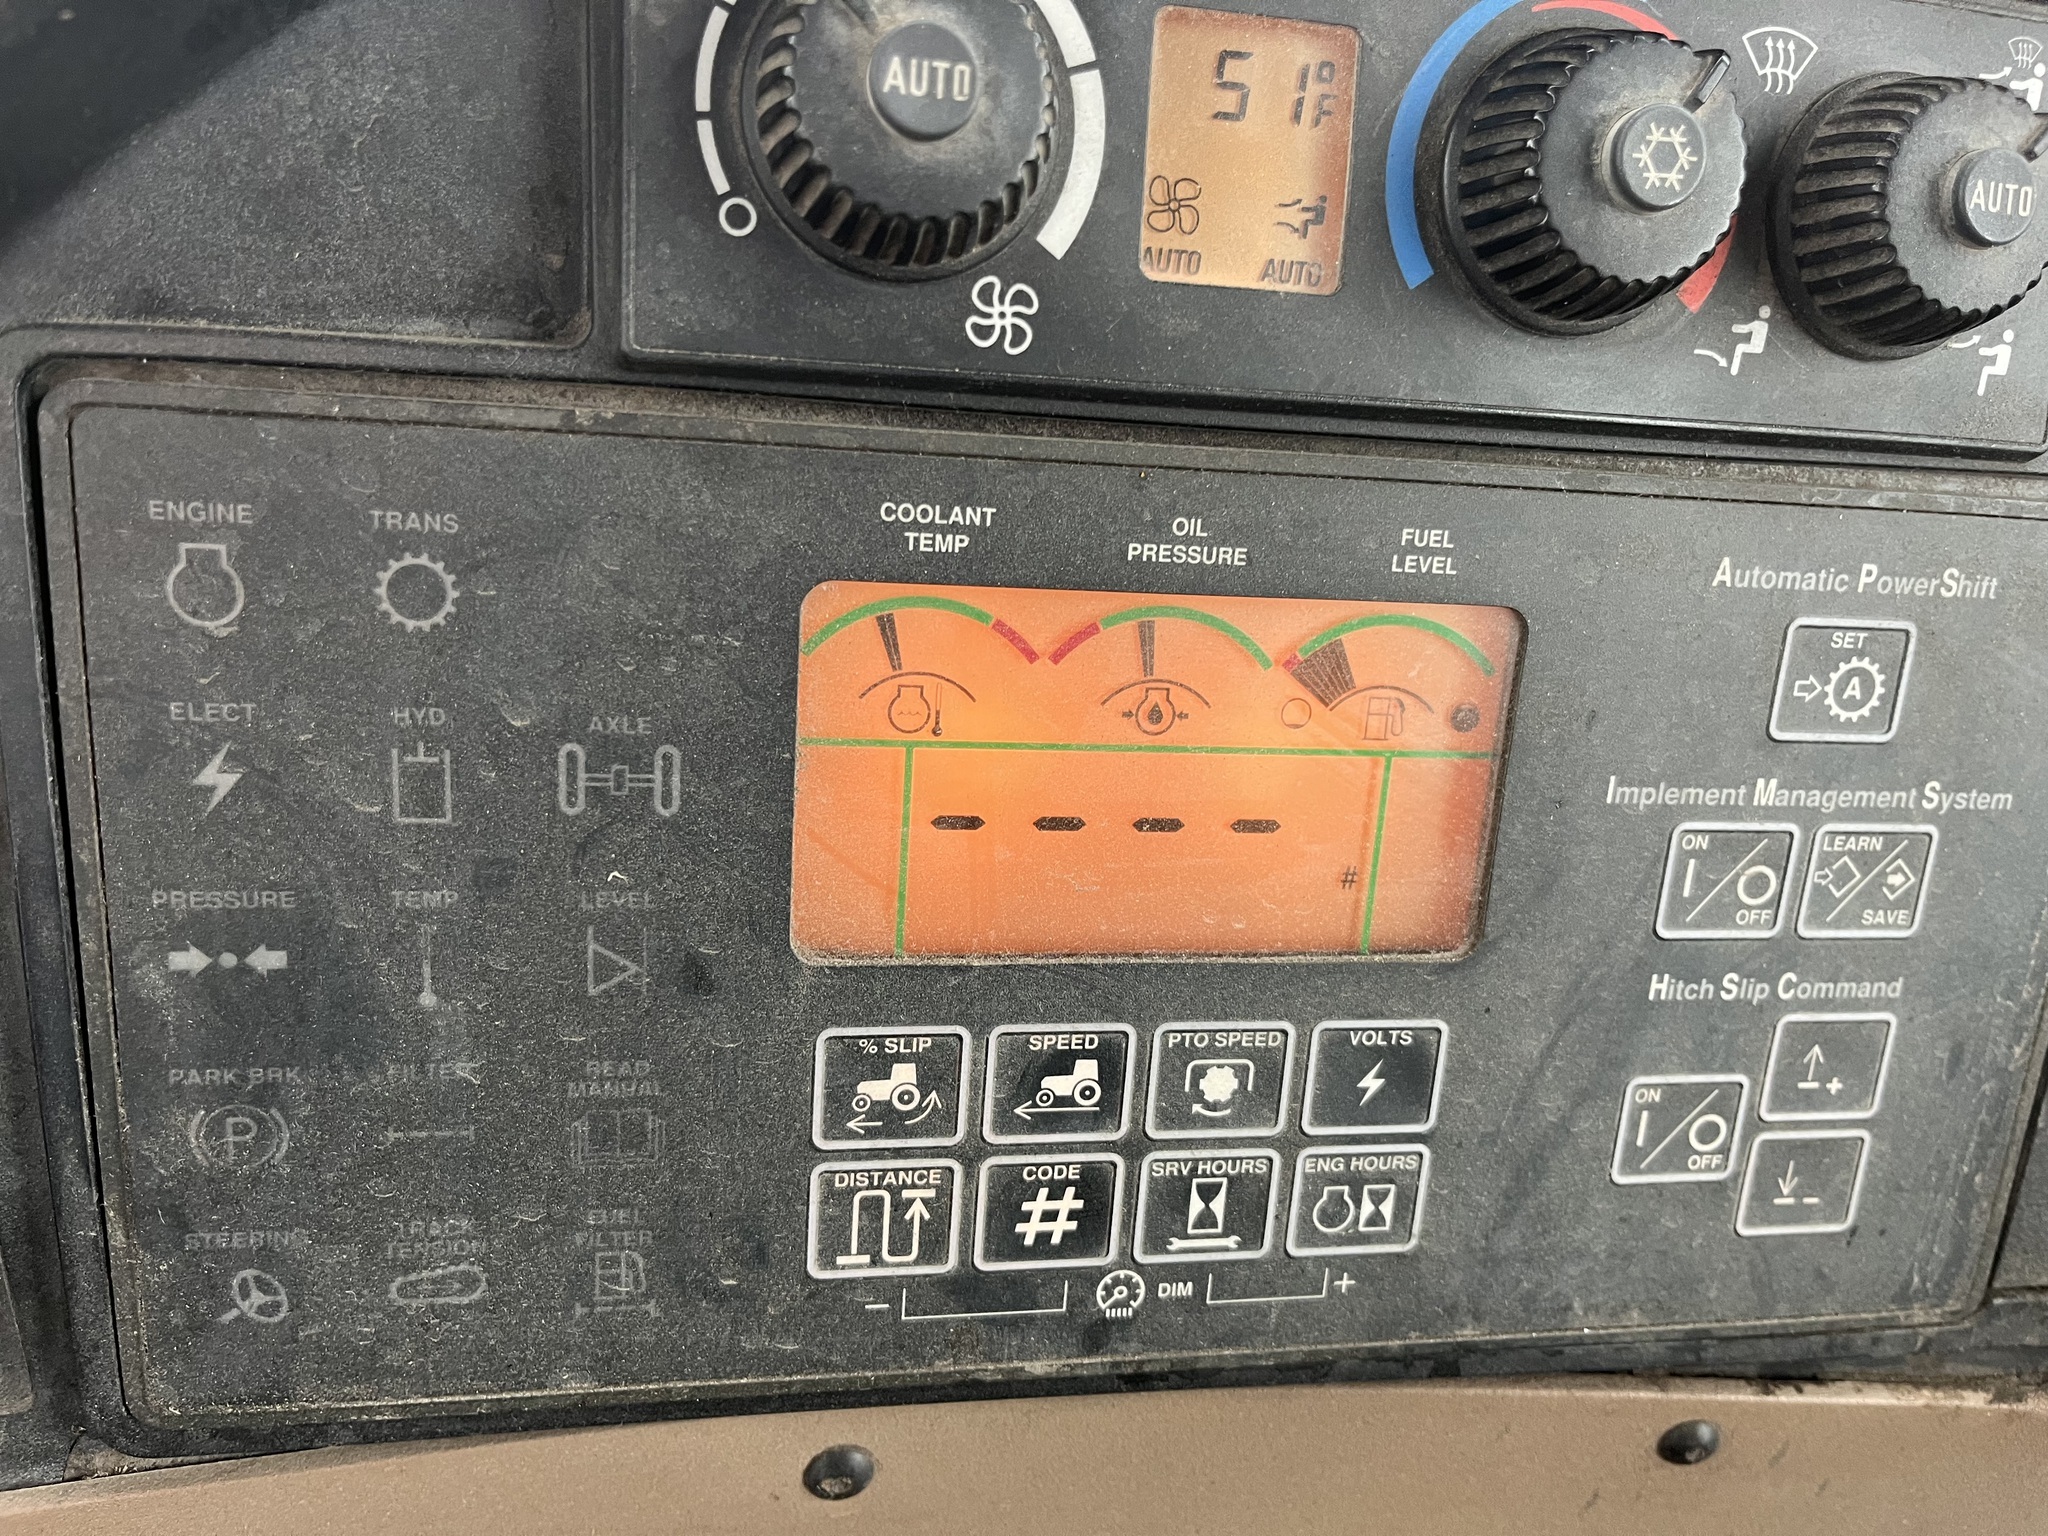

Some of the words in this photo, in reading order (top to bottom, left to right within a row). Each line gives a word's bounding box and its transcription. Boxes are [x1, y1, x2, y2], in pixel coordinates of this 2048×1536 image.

[882, 53, 973, 102] AUTO
[1970, 179, 2033, 218] AUTO
[1142, 246, 1202, 275] AUTO
[1260, 258, 1323, 287] AUTO
[148, 500, 253, 525] ENGINE
[369, 510, 460, 534] TRANS
[880, 502, 997, 527] COOLANT
[1171, 517, 1209, 538] OIL
[905, 531, 970, 553] TEMP
[1400, 528, 1455, 549] FUEL
[1126, 543, 1248, 567] PRESSURE
[1391, 553, 1458, 576] LEVEL
[1711, 556, 1850, 592] Automatic
[1857, 563, 1999, 600] PowerShift
[1830, 632, 1869, 650] SET
[169, 702, 257, 723] ELECT
[393, 706, 447, 728] HYD
[589, 715, 652, 736] AXLE
[1606, 775, 1746, 809] Implement
[1752, 778, 1917, 813] Management
[1921, 781, 2014, 815] System
[1681, 834, 1709, 851] ON
[1822, 835, 1883, 852] LEARN
[152, 889, 298, 911] PRESSURE
[390, 890, 458, 911] TEMP
[1735, 908, 1772, 926] OFF
[1861, 909, 1910, 926] SAVE
[1648, 973, 1714, 1001] Hitch
[1719, 972, 1770, 1006] Slip
[1777, 971, 1904, 1000] Command
[858, 1038, 878, 1054] %
[884, 1037, 932, 1053] SLIP
[1028, 1034, 1099, 1050] SPEED
[1168, 1031, 1209, 1048] PTO
[1214, 1031, 1282, 1047] SPEED
[1350, 1030, 1413, 1046] VOLTS
[168, 1067, 237, 1087] PARK
[244, 1067, 299, 1087] BRK
[1634, 1088, 1661, 1104] ON
[1022, 1164, 1081, 1181] CODE
[1151, 1160, 1193, 1177] SRV
[1198, 1158, 1269, 1176] HOURS
[1304, 1157, 1344, 1174] ENG
[1350, 1155, 1418, 1172] HOURS
[1687, 1154, 1723, 1171] OFF
[834, 1170, 942, 1188] DISTANCE
[184, 1231, 309, 1252] STEERING
[1157, 1282, 1193, 1298] DIM
